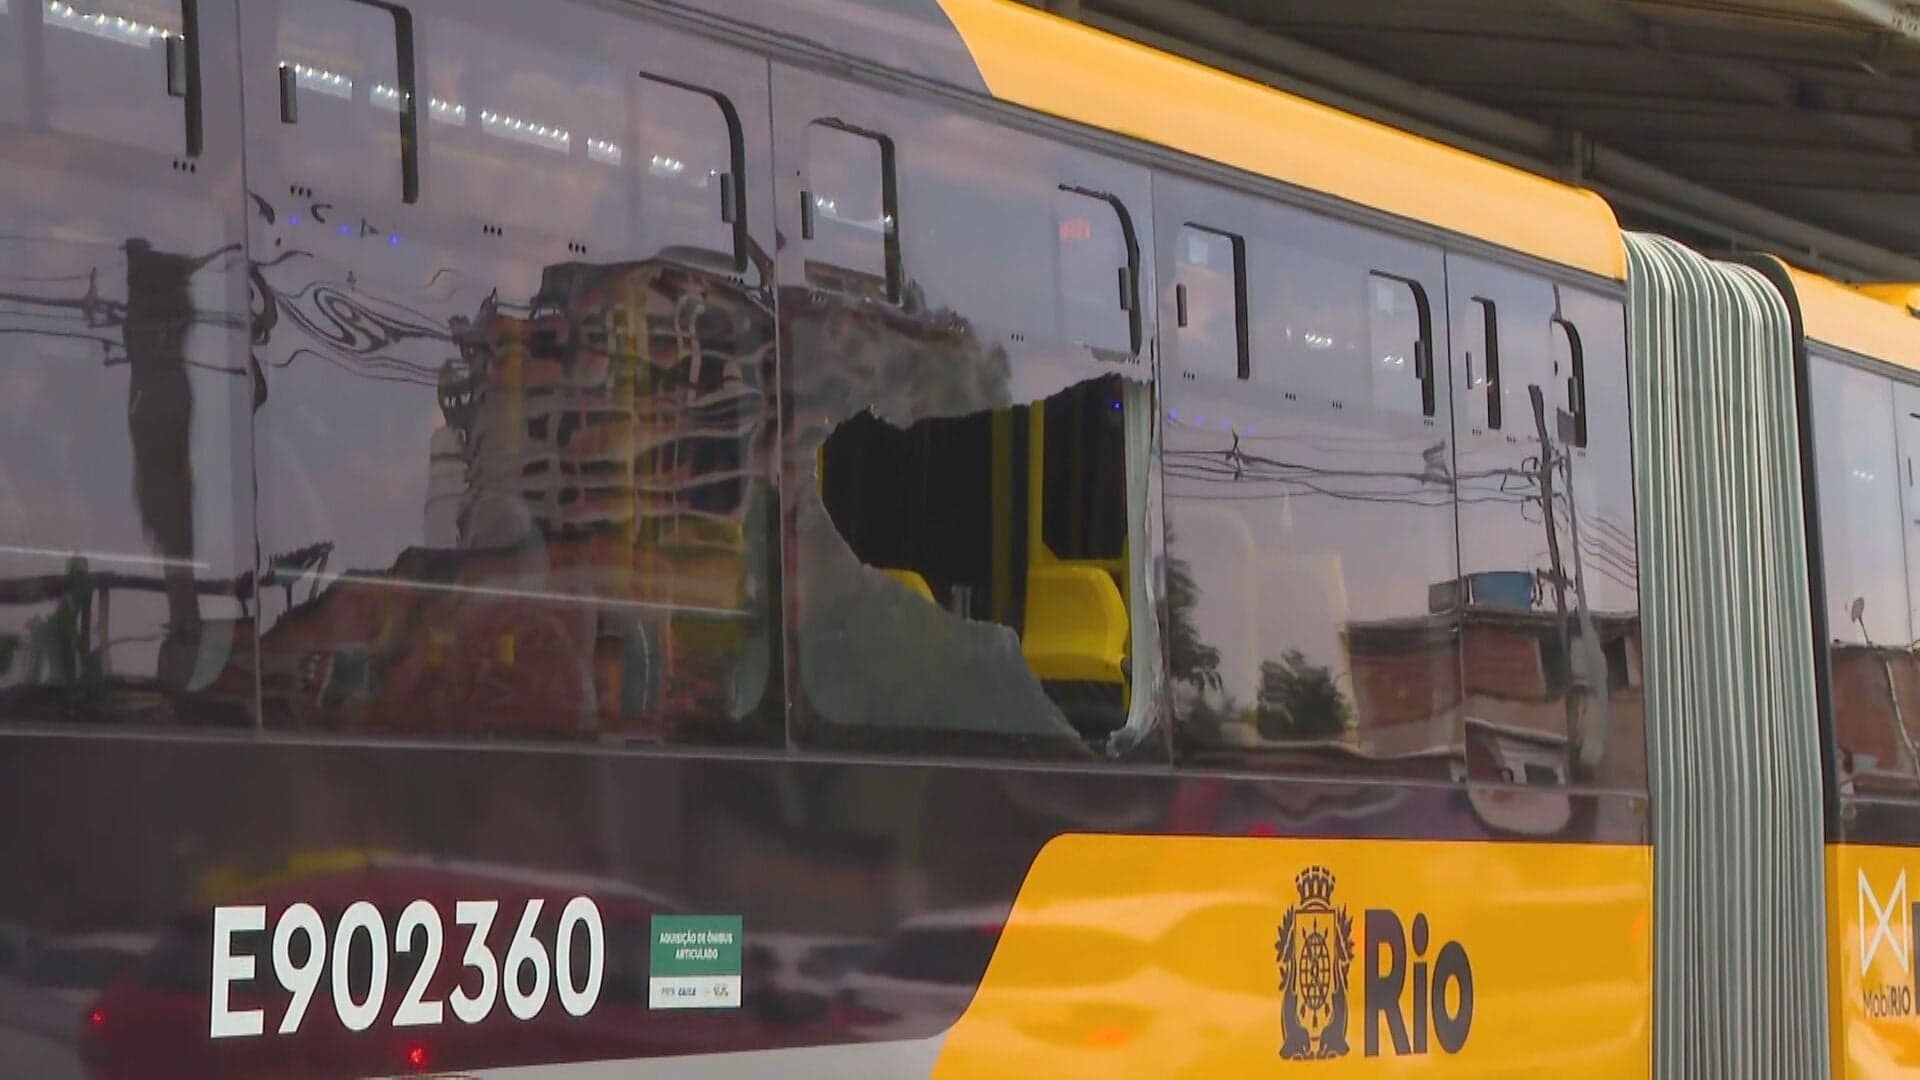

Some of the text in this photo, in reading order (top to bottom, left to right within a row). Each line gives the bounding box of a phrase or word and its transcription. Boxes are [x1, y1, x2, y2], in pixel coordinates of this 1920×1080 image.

[675, 948, 719, 960] ARTICULADO
[697, 933, 706, 944] DE
[210, 896, 605, 1039] E902360
[1364, 909, 1474, 1058] Rio
[1863, 985, 1911, 1018] MobiRIO
